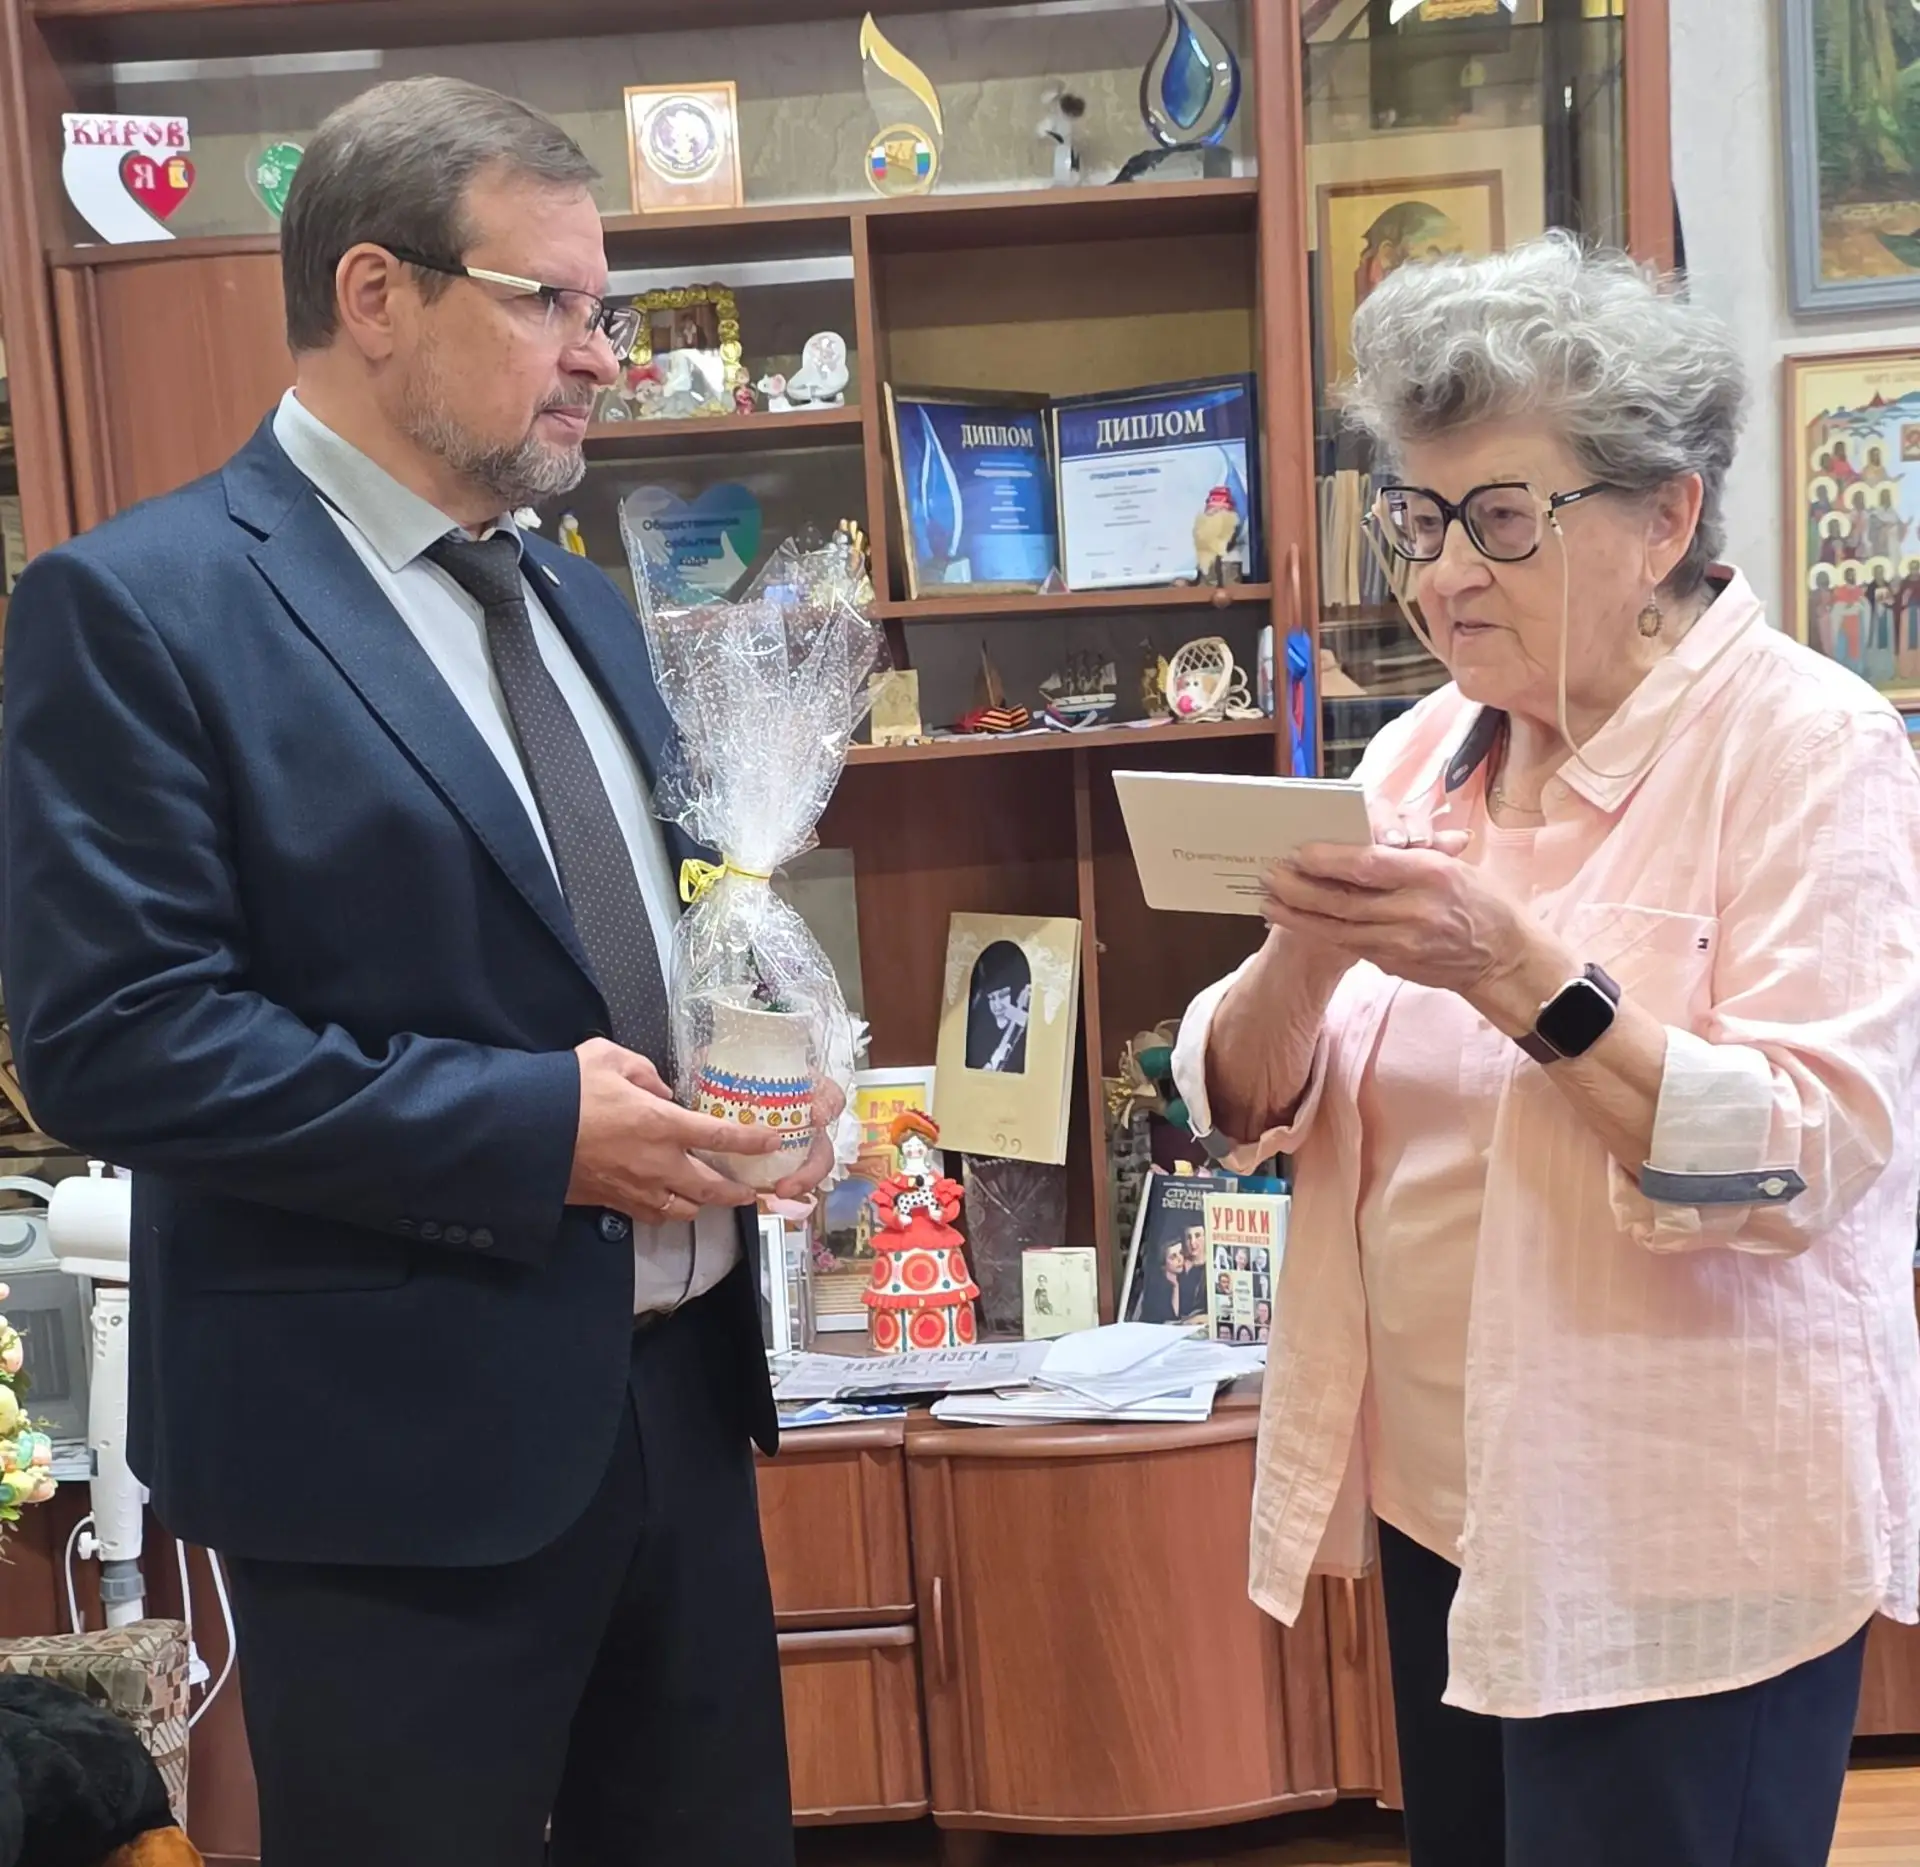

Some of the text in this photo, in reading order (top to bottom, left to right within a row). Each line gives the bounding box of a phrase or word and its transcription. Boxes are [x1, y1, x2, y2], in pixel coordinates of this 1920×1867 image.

[71, 119, 185, 147] КИРОВ
[133, 163, 155, 189] Я
[961, 424, 1034, 448] ДИПЛОМ
[1097, 408, 1206, 449] ДИПЛОМ
[1212, 1207, 1269, 1234] УРОКИ
[927, 1350, 988, 1363] ГАЗЕТА
